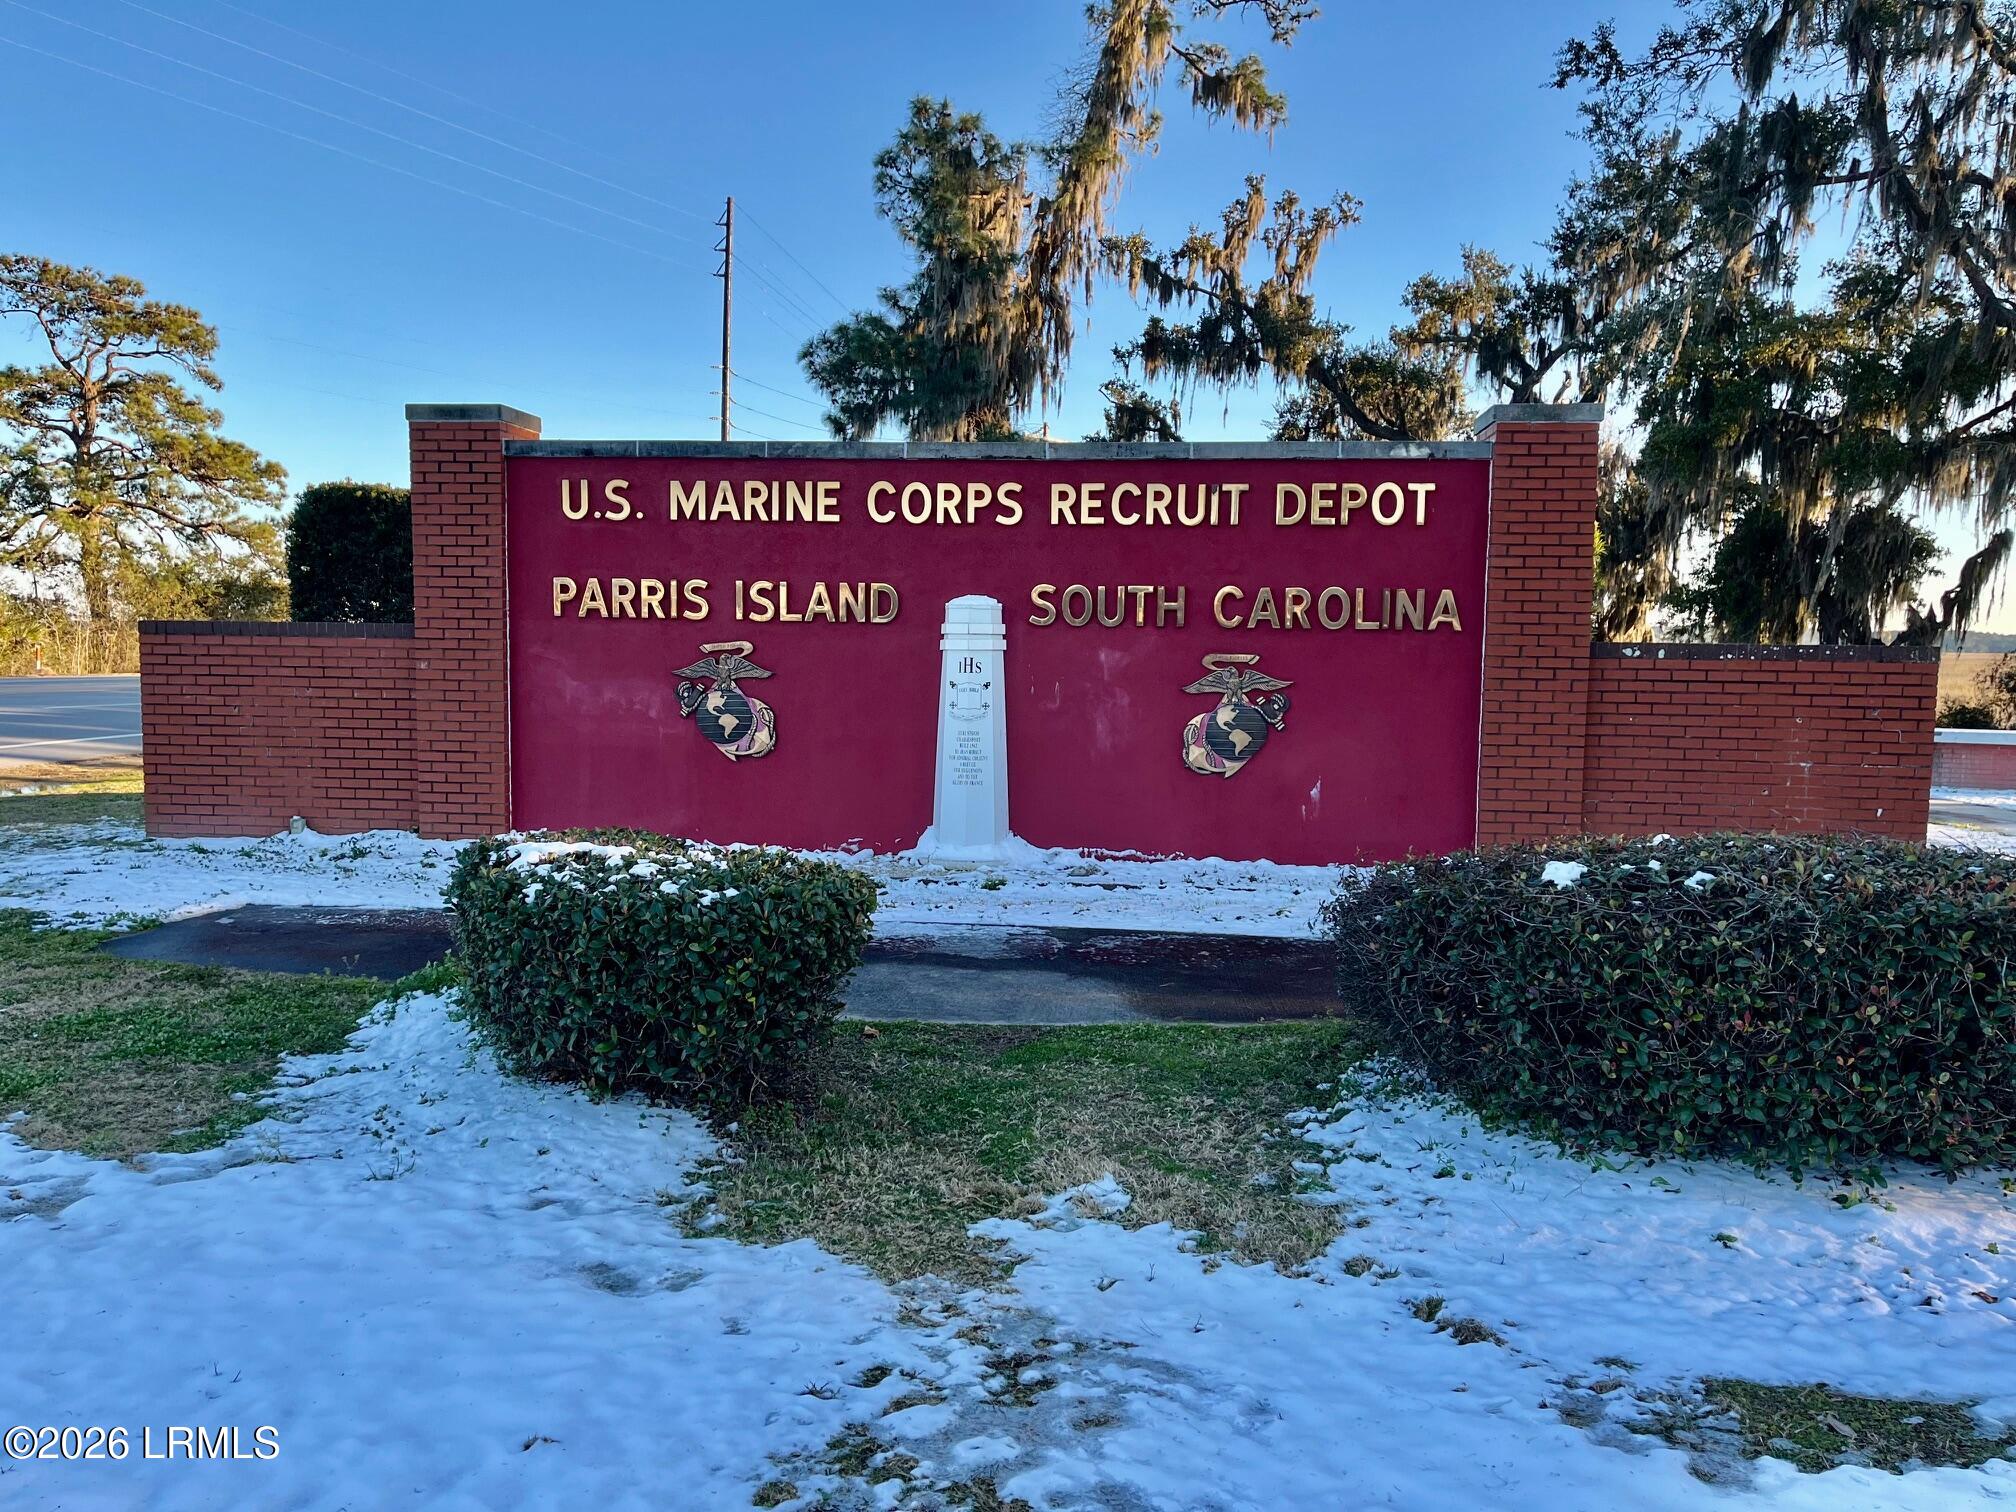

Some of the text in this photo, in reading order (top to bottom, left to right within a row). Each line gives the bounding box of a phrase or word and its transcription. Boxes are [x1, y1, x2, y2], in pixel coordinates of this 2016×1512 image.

[560, 478, 1437, 527] U.S. MARINE CORPS RECRUIT DEPOT
[552, 576, 899, 624] PARRIS ISLAND
[1028, 583, 1462, 632] SOUTH CAROLINA
[958, 656, 982, 674] IHS
